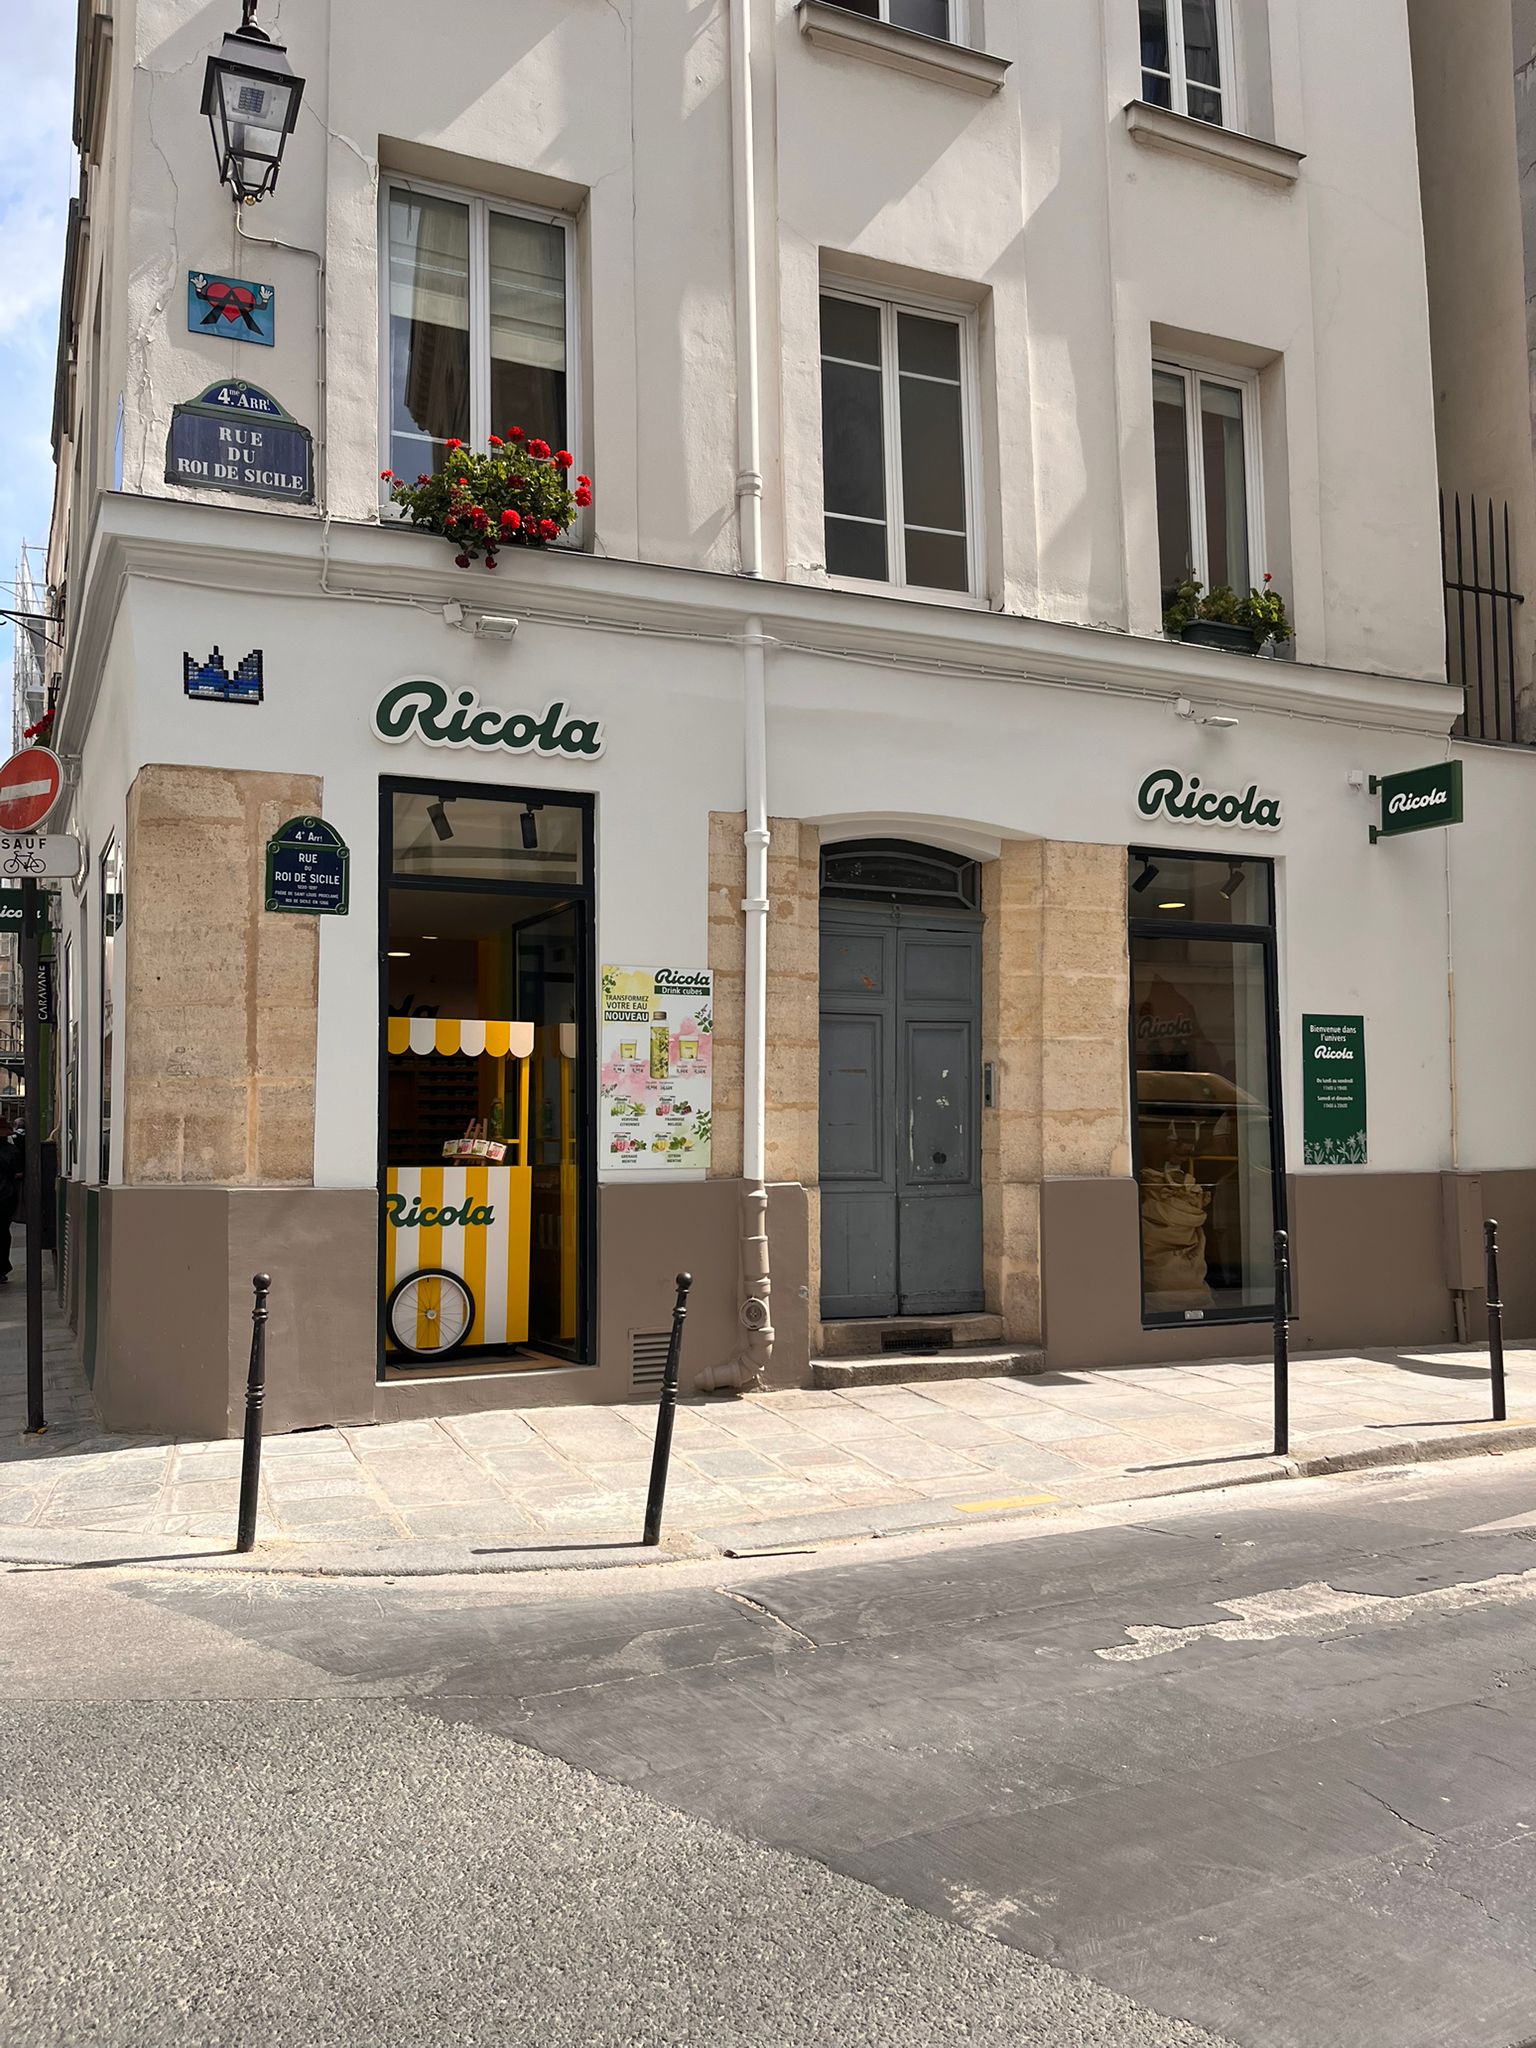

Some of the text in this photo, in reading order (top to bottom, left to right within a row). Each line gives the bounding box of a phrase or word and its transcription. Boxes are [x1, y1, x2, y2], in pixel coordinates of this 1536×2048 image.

[219, 426, 263, 447] RUE
[228, 447, 256, 464] DU
[177, 457, 304, 490] ROI DE SICILE
[376, 680, 601, 754] Ricola
[1138, 769, 1281, 827] Ricola
[1388, 788, 1447, 814] Ricola
[2, 838, 47, 850] SAUF
[298, 853, 318, 864] RUE
[275, 871, 340, 885] ROI DE SICILE
[654, 968, 710, 986] Ricola
[38, 965, 48, 1020] CARAVANE
[605, 994, 649, 1002] TRANSFORMEZ
[662, 986, 703, 995] Drink cubes
[606, 1001, 648, 1010] VOTRE EAU
[605, 1011, 648, 1021] NOUVEAU
[1309, 1025, 1357, 1034] Bienvenue dans
[1320, 1033, 1346, 1042] l'univers
[1314, 1045, 1354, 1060] Ricola
[386, 1193, 495, 1228] Ricola
